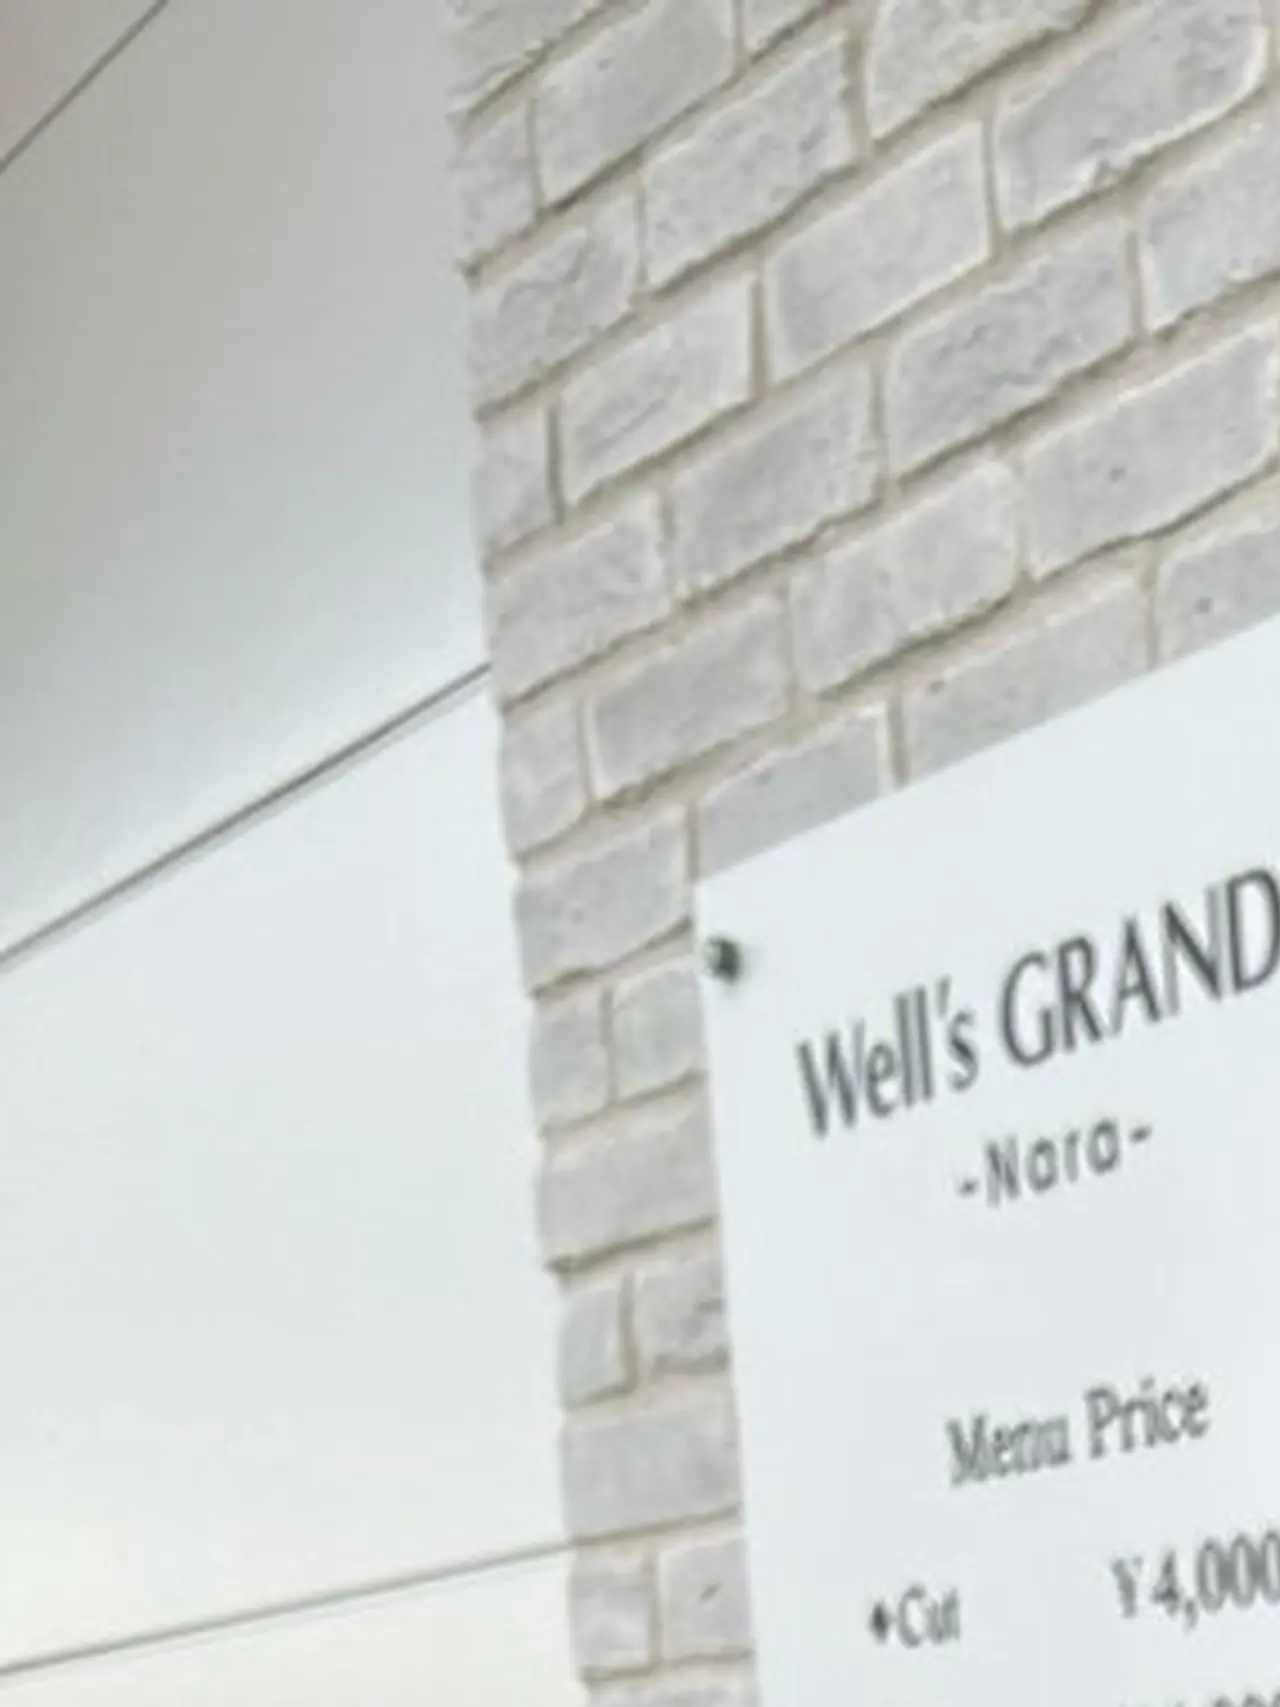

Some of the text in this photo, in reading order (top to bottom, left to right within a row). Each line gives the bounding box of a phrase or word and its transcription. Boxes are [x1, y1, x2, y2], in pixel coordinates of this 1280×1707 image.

[796, 976, 979, 1139] Well's
[946, 1376, 1209, 1487] Menu Price
[898, 1585, 961, 1649] Cut
